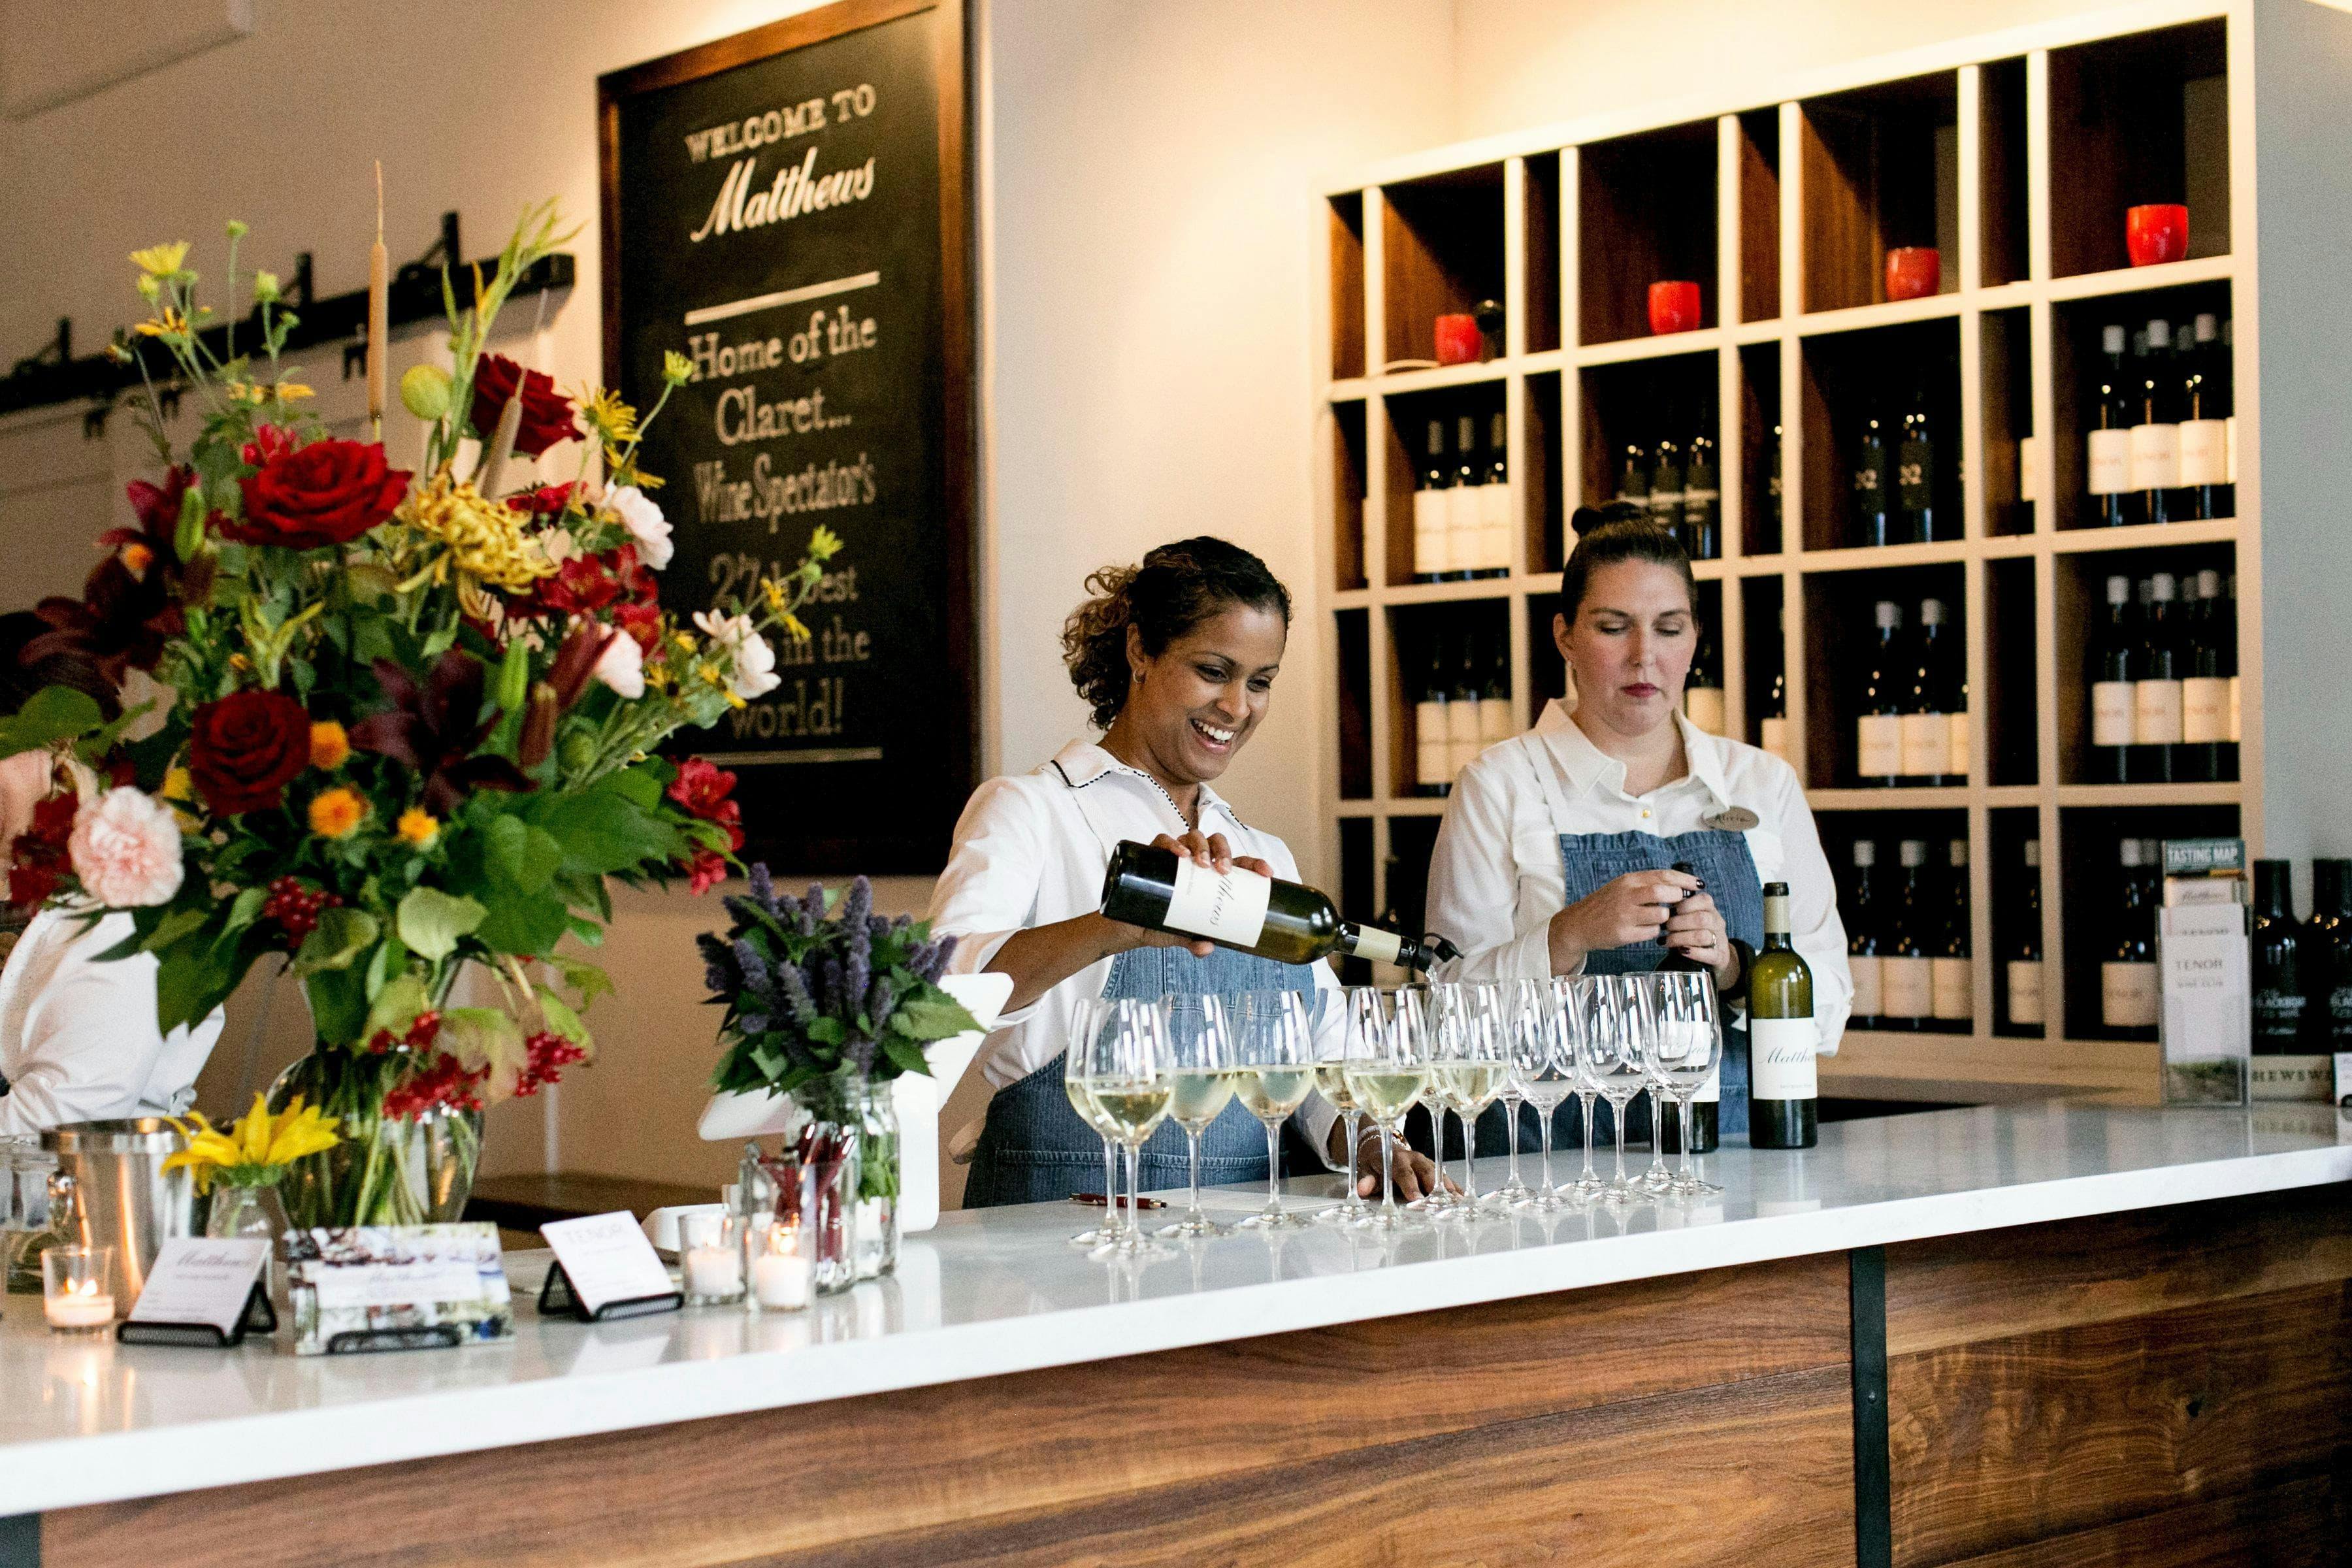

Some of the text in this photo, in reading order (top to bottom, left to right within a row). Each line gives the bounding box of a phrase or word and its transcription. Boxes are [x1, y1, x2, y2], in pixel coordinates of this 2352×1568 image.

[685, 84, 877, 163] WELCOME TO
[690, 146, 876, 243] Matthews
[689, 305, 877, 382] Home of the
[715, 385, 852, 446] Claret...
[693, 459, 753, 523] Wine
[821, 615, 872, 662] the
[727, 677, 844, 740] world!
